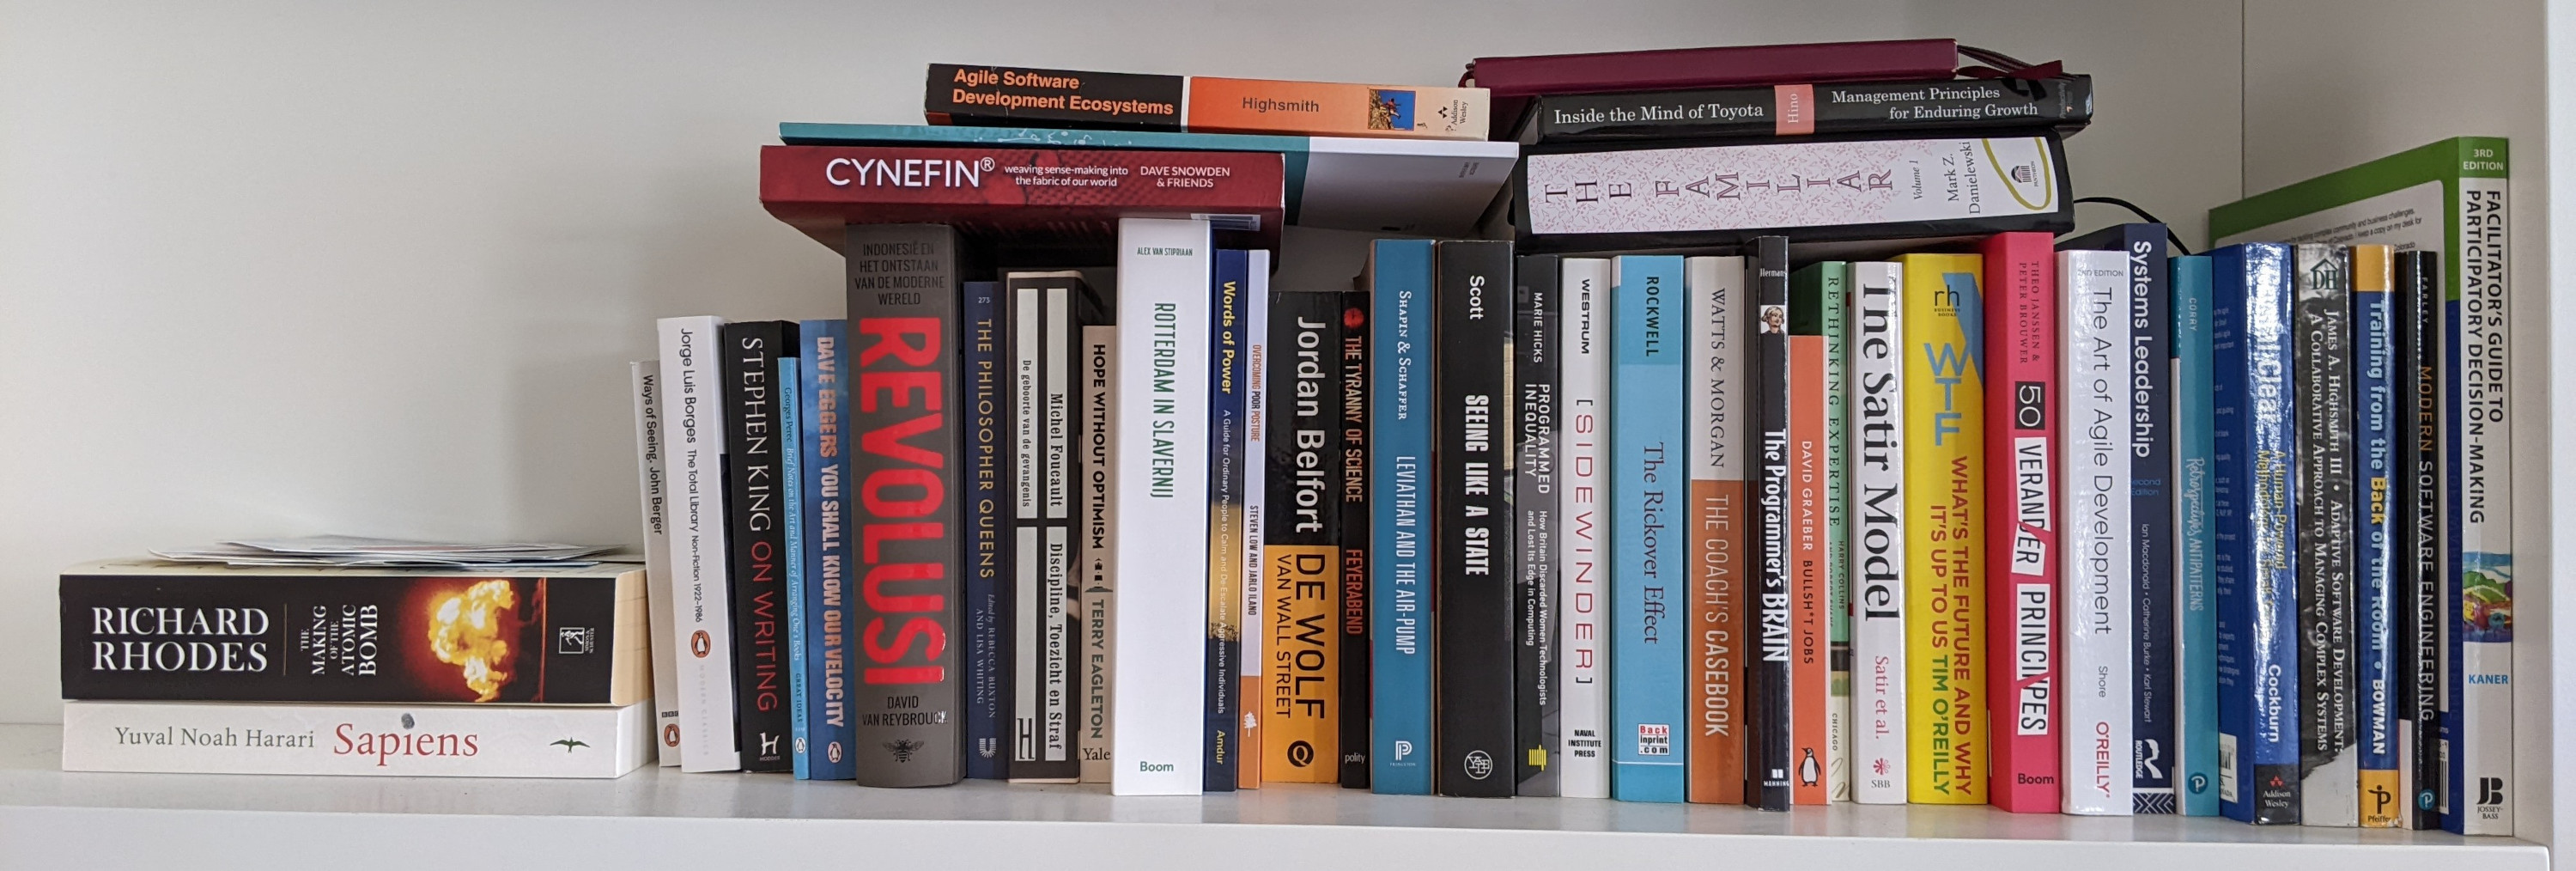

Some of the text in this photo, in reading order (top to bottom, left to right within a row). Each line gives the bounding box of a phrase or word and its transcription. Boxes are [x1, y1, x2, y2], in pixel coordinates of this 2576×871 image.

[953, 89, 1174, 115] Development Ecosystems
[954, 69, 1079, 88] Agile Software
[1242, 96, 1320, 113] Highsmith
[1554, 103, 1764, 125] Inside the Mind of Toyota
[1788, 94, 1799, 124] Hino
[1832, 88, 2000, 104] Management Principles
[1889, 103, 2038, 119] for Enduring Growth
[1005, 166, 1128, 176] weaving sense-making into
[1016, 176, 1030, 185] the
[1032, 176, 1059, 186] fabric
[1061, 176, 1071, 186] of
[1091, 177, 1117, 186] world
[1140, 166, 1230, 177] DAVE SNOWDEN
[1157, 178, 1213, 187] & FRIENDS
[1944, 154, 1959, 202] Mark Z.
[1966, 141, 1981, 215] Danielewski
[2464, 161, 2504, 170] EDITION
[1469, 275, 1485, 320] Scott
[1581, 279, 1589, 354] WESTRUM
[1646, 277, 1659, 356] ROCKWELL
[2487, 191, 2503, 423] FACILITATOR'S GUIDE TO
[1222, 281, 1236, 393] Words of Power
[2130, 241, 2154, 458] Systems Leadership
[2467, 191, 2484, 523] PARTICIPATORY DECISION-MAKING
[679, 329, 696, 443] Jorge Luis Borges
[817, 337, 838, 458] DAVE EGGERS
[1150, 303, 1176, 498] ROTTERDAM IN SLAVERNIJ
[1345, 336, 1362, 502] THE TYRANNY OF SCIENCE
[642, 375, 662, 535] Ways of Seeing. John Berger
[742, 338, 770, 531] STEPHEN KING
[978, 320, 994, 578] THE PHILOSOPHER QUEENS
[1050, 393, 1063, 506] Michel Foucault
[1093, 344, 1105, 548] HOPE WITHOUT OPTIMISM
[1296, 317, 1326, 533] Jordan Belfort
[2089, 287, 2113, 634] The Art of Agile Development
[688, 450, 699, 532] The Total Library
[860, 317, 945, 684] REVOLUSI
[1465, 395, 1489, 576] SEEING LIKE A STATE
[1802, 441, 1813, 551] DAVID GRAEBER
[1396, 456, 1415, 655] LEVIATHAN AND THE AIR-PUMP
[2419, 367, 2434, 721] MODERN SOFTWARE ENGINEERING
[92, 606, 269, 636] RICHARD
[751, 542, 777, 711] ON WRITING
[821, 464, 844, 727] YOU SHALL KNOW OUR VELOCITY
[1346, 550, 1363, 635] FEYERABEND
[1705, 495, 1729, 737] THE COACH'S CASEBOOK
[1952, 455, 1971, 795] WHAT'S THE FUTURE AND WHY
[92, 640, 268, 673] RHODES
[301, 629, 309, 651] THE
[312, 605, 326, 675] MAKING
[331, 622, 339, 660] OF THE
[343, 605, 356, 677] ATOMIC
[360, 605, 378, 676] BOMB
[1048, 543, 1062, 749] Discipline, Toezicht en Straf
[1091, 600, 1103, 739] TERRY EAGLETON
[1296, 554, 1325, 719] DE WOLF
[887, 697, 918, 709] DAVID
[2099, 666, 2108, 697] Shore
[2269, 664, 2281, 743] Cockburn
[2372, 679, 2385, 754] BOWMAN
[2469, 674, 2508, 685] KANER
[115, 727, 314, 747] Yuval Noah Harari
[334, 724, 479, 766] Sapiens
[862, 711, 947, 726] VAN REYBROUCK
[1083, 748, 1110, 760] Yale
[1139, 761, 1174, 771] Boom
[1345, 752, 1365, 764] polity
[2019, 774, 2054, 784] Boom
